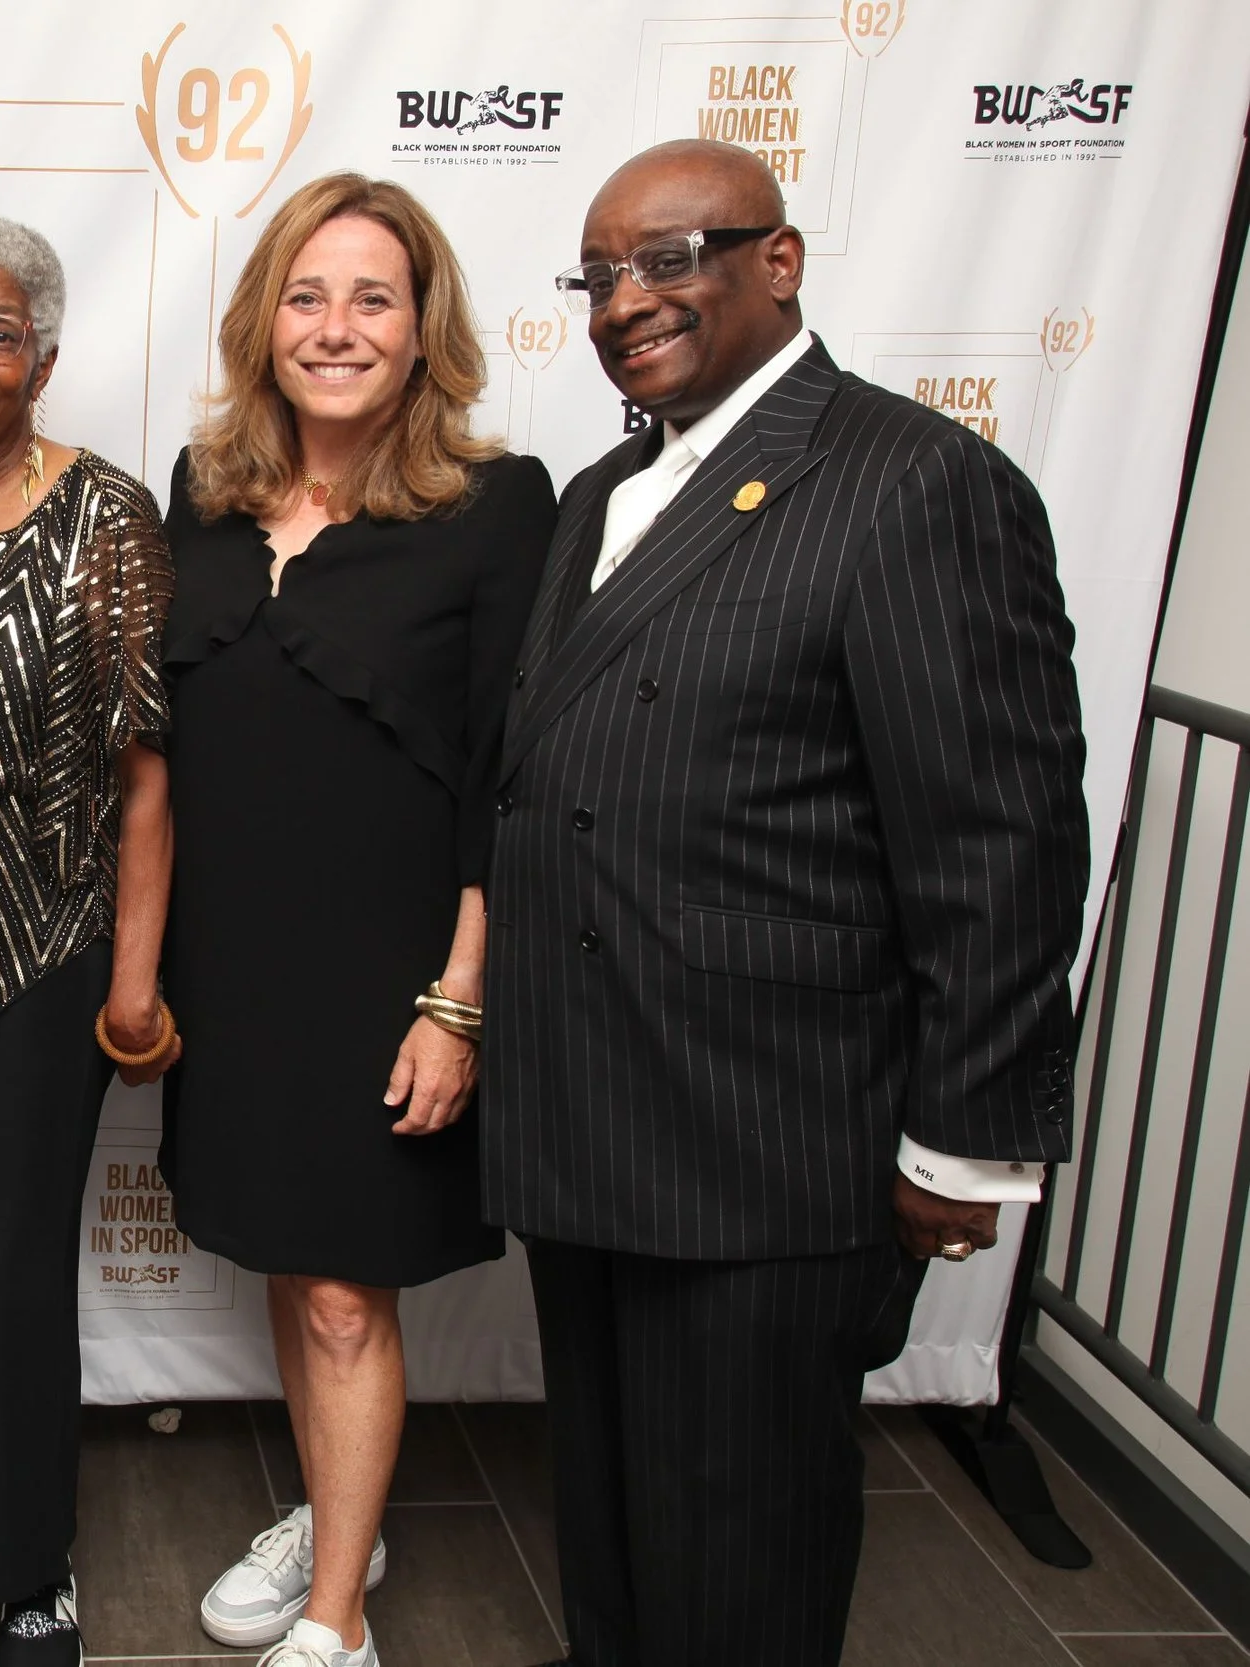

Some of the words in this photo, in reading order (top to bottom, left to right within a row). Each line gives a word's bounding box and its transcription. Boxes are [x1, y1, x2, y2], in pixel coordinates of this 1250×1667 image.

[855, 2, 891, 37] 92
[708, 65, 796, 101] BLACK
[175, 68, 270, 162] 92
[698, 107, 799, 142] WOMEN
[392, 144, 421, 152] BLACK
[424, 144, 458, 152] WOMEN
[460, 144, 469, 152] IN
[472, 144, 501, 152] SPORT
[504, 144, 561, 152] FOUNDATION
[965, 140, 994, 148] BLACK
[996, 140, 1025, 148] WOMEN
[1027, 140, 1036, 148] IN
[1039, 140, 1072, 148] SPORT
[1074, 139, 1125, 148] FOUNDATION
[994, 154, 1057, 162] ESTABLISHED
[1076, 153, 1096, 161] 1992
[506, 158, 527, 166] 1992
[520, 320, 553, 352] 92
[1050, 320, 1079, 353] 92
[914, 377, 997, 411] BLACK
[107, 1164, 166, 1191] BLAC
[915, 1164, 934, 1182] MH
[91, 1227, 113, 1253] IN
[120, 1227, 188, 1254] SPORT
